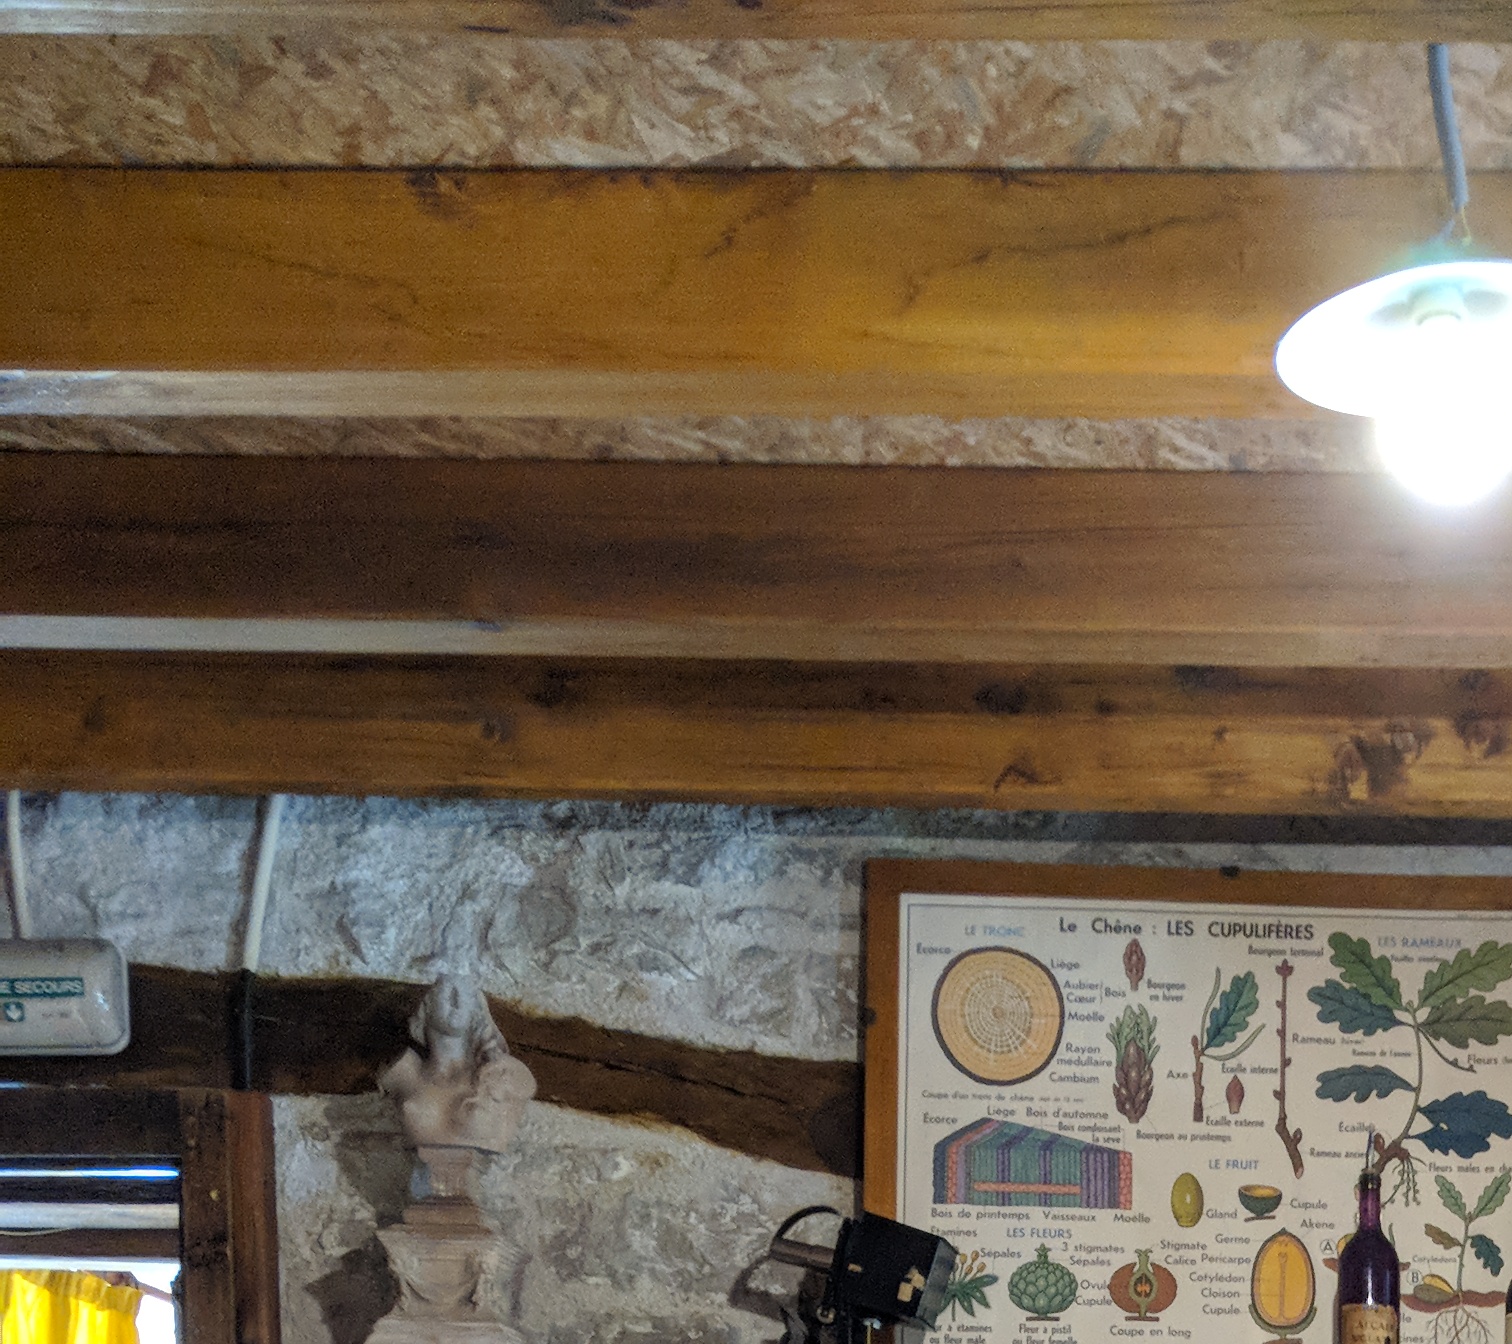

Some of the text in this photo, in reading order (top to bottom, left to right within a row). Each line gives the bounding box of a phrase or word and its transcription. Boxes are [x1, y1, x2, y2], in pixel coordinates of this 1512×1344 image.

[965, 925, 1024, 937] LE TRONC
[1059, 916, 1314, 940] Le Chêne LES CUPULIFÈRES
[1378, 937, 1462, 948] LES RAMEAUX
[15, 980, 82, 995] SECOURS
[1105, 988, 1126, 998] Bois
[1292, 1033, 1336, 1045] Rameau
[1065, 1043, 1101, 1055] Rayon
[1467, 1055, 1498, 1065] Fleurs
[1049, 1073, 1100, 1084] Cambium
[1167, 1070, 1188, 1078] Axe
[1026, 1108, 1047, 1117] Bois
[1053, 1108, 1108, 1119] d'automne
[1177, 1132, 1231, 1142] au printemps
[1208, 1159, 1259, 1170] LE FRUIT
[1428, 1163, 1452, 1173] Fleurs
[1289, 1199, 1328, 1210] Cupule
[931, 1208, 1030, 1221] Bois de printemps
[1043, 1211, 1096, 1222] Vaisseaux
[1206, 1209, 1238, 1219] Gland
[1006, 1228, 1072, 1239] LES FLEURS
[1215, 1234, 1250, 1244] Germe
[1062, 1242, 1125, 1254] 3 stigmates
[1160, 1240, 1207, 1251] Stigmate
[980, 1248, 1022, 1259] Sépales
[1069, 1256, 1111, 1267] Sépales
[1164, 1256, 1196, 1266] Calice
[1201, 1288, 1240, 1298] Cloison
[1075, 1296, 1113, 1306] Cupule
[1202, 1304, 1241, 1315] Cupule
[1019, 1324, 1072, 1336] Fleur pistil
[1110, 1326, 1144, 1337] Coupe
[1167, 1327, 1191, 1339] long
[930, 1336, 962, 1344] ou fleur
